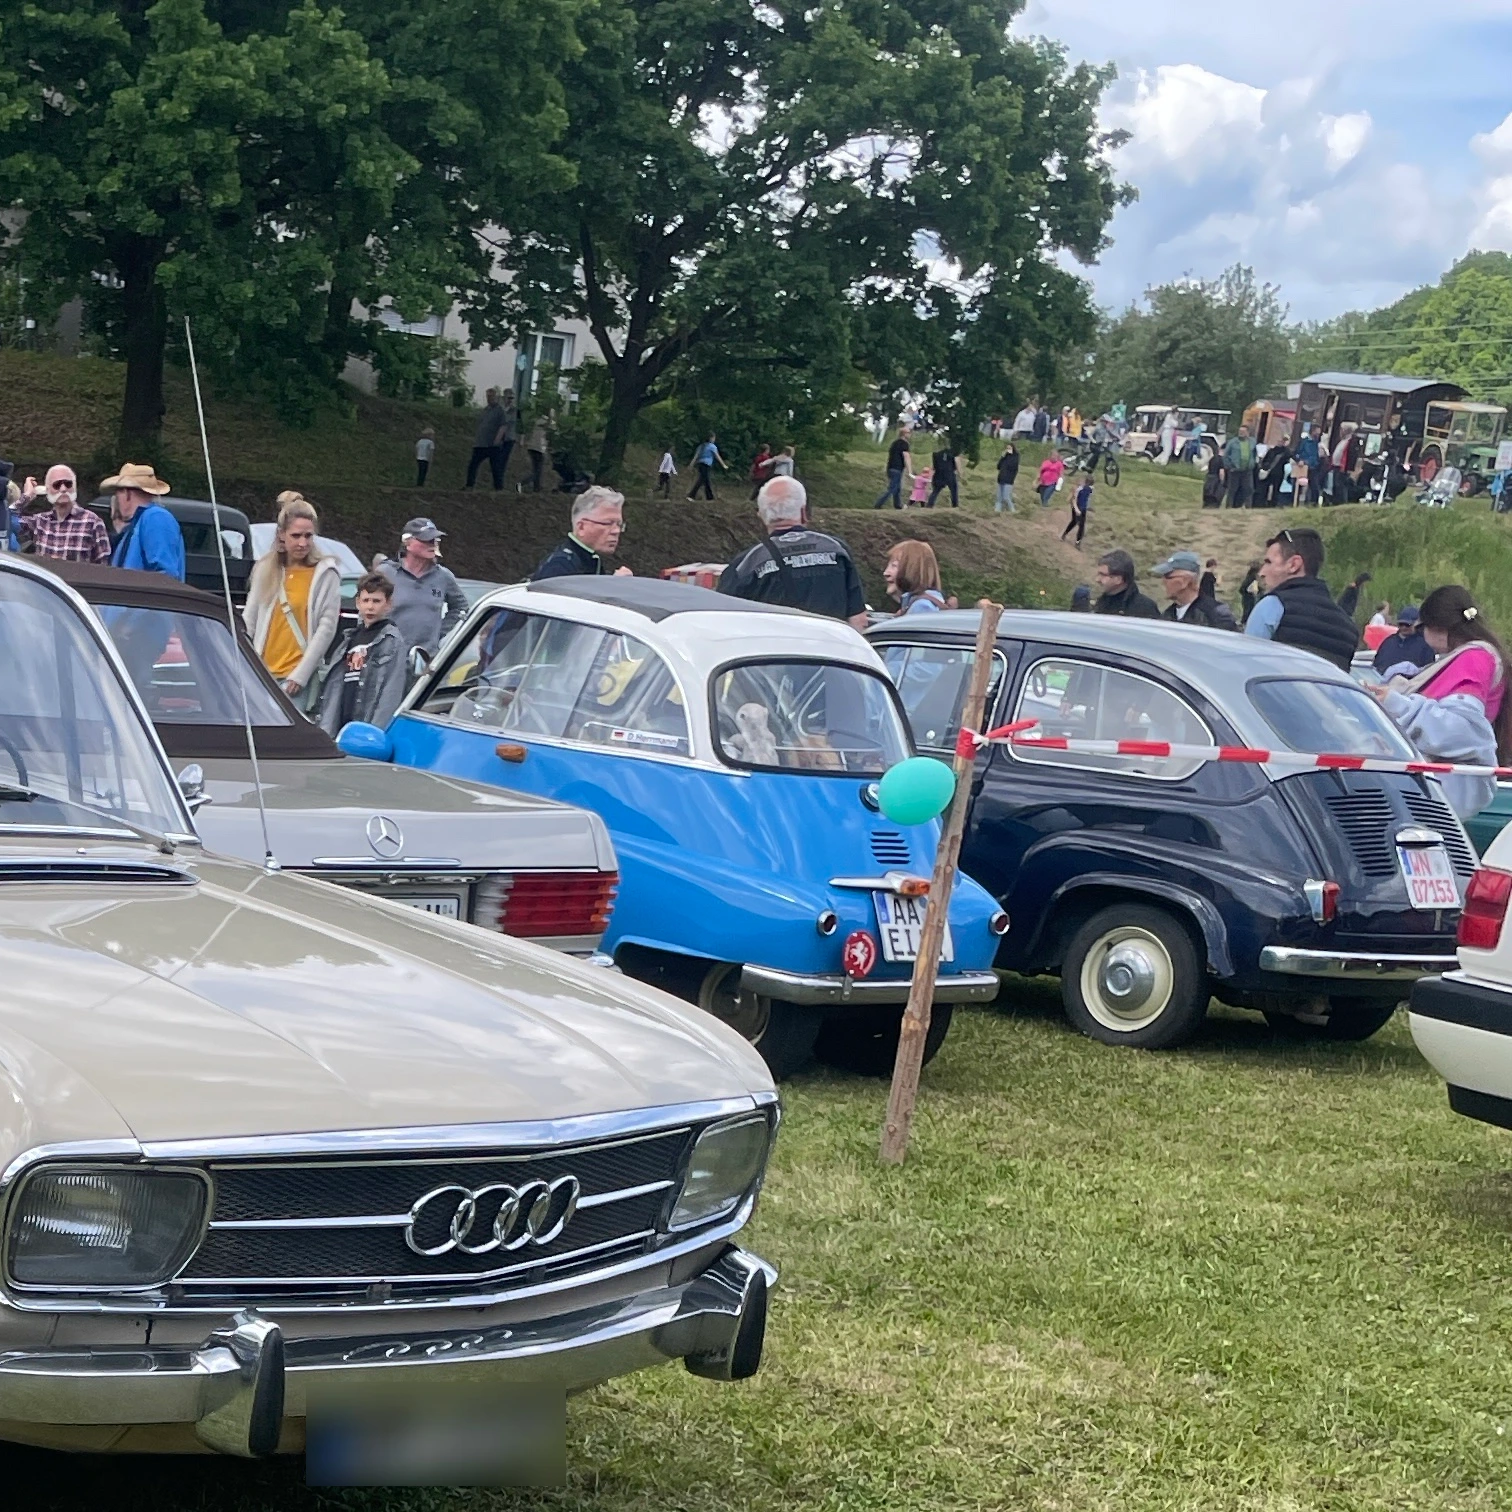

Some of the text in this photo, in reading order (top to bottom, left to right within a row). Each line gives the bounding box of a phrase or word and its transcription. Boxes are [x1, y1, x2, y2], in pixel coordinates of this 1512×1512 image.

[1409, 851, 1432, 876] WN
[1411, 879, 1455, 904] 07153
[892, 897, 921, 925] AA
